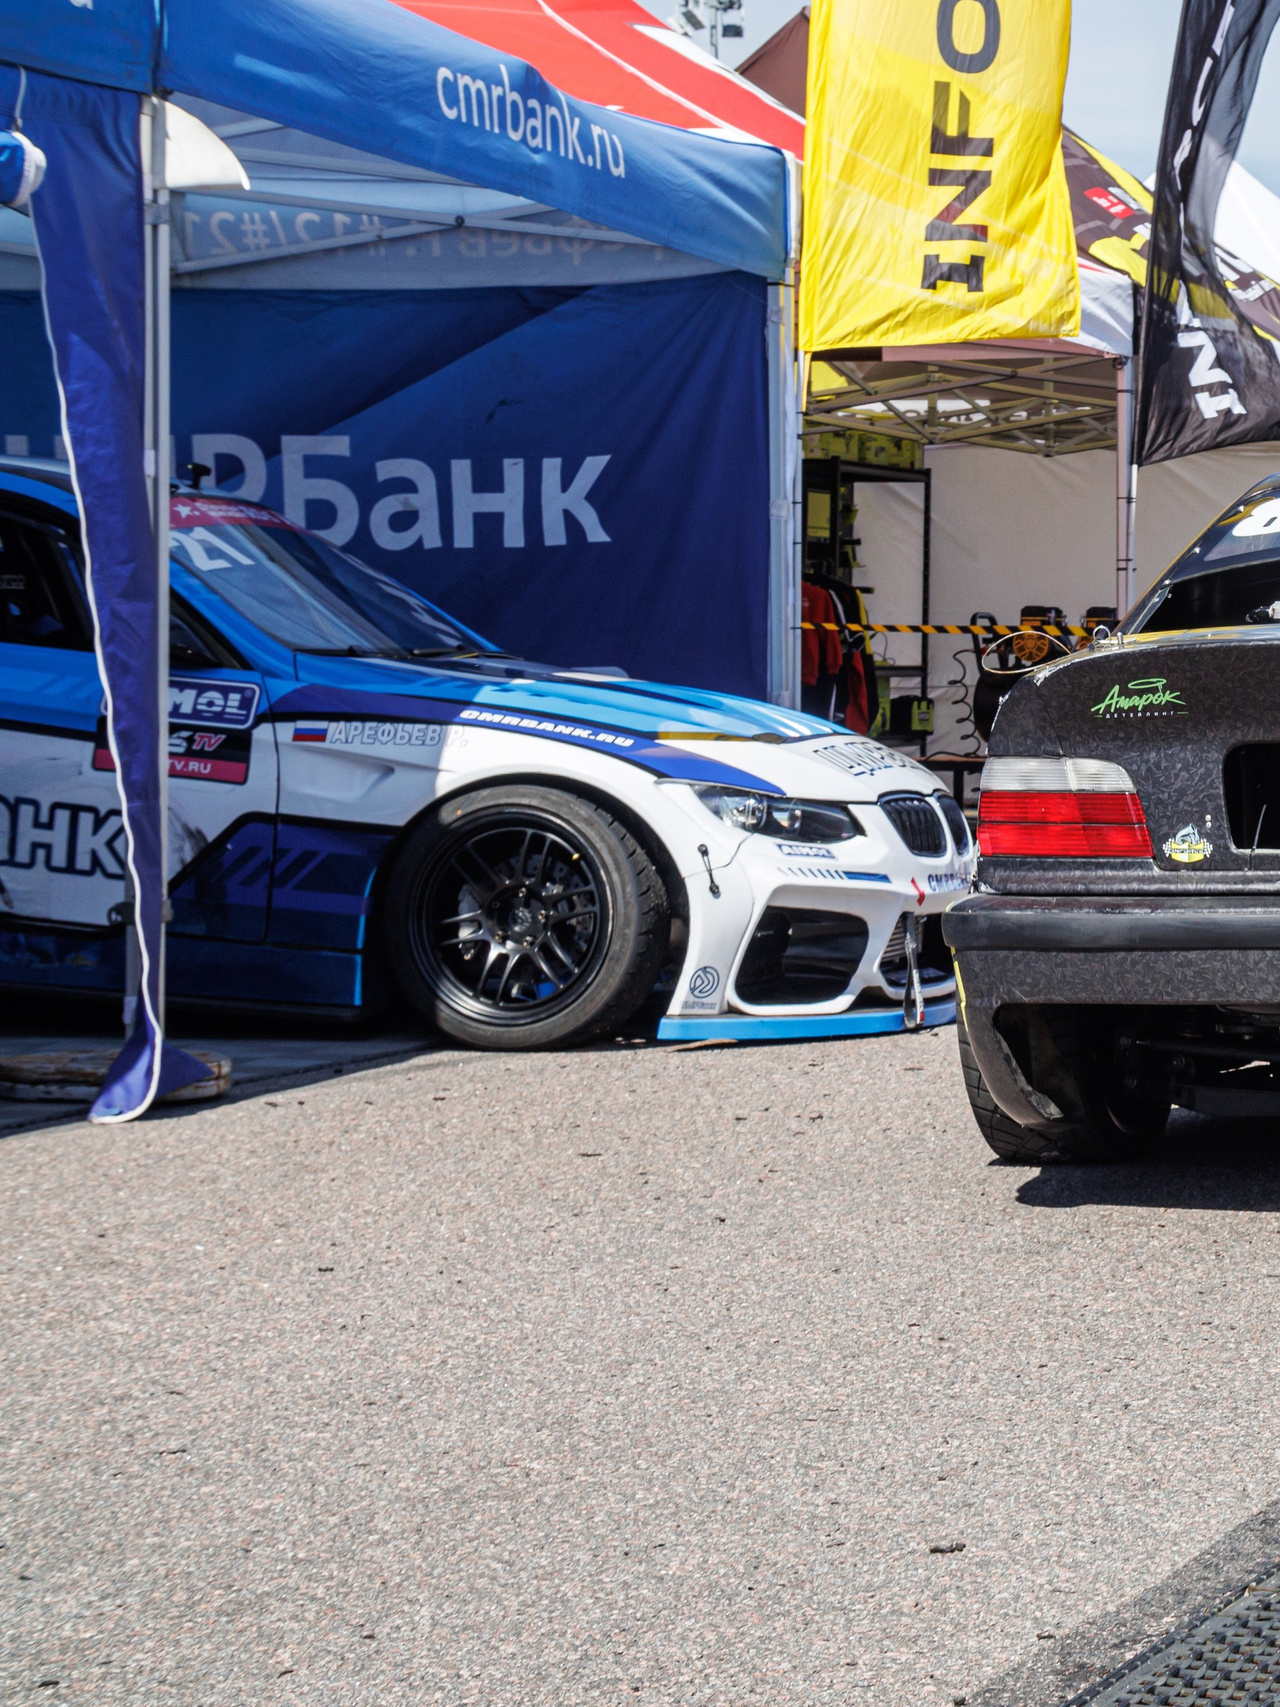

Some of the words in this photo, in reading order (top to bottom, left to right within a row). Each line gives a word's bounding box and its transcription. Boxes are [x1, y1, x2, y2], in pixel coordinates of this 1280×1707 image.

[436, 63, 626, 178] cmrbank.ru
[169, 687, 247, 715] MOL
[1105, 710, 1175, 719] ДЕТЕЙЛИНГ
[330, 720, 442, 747] АРЕФЬЕВ
[168, 759, 211, 774] TV.RU
